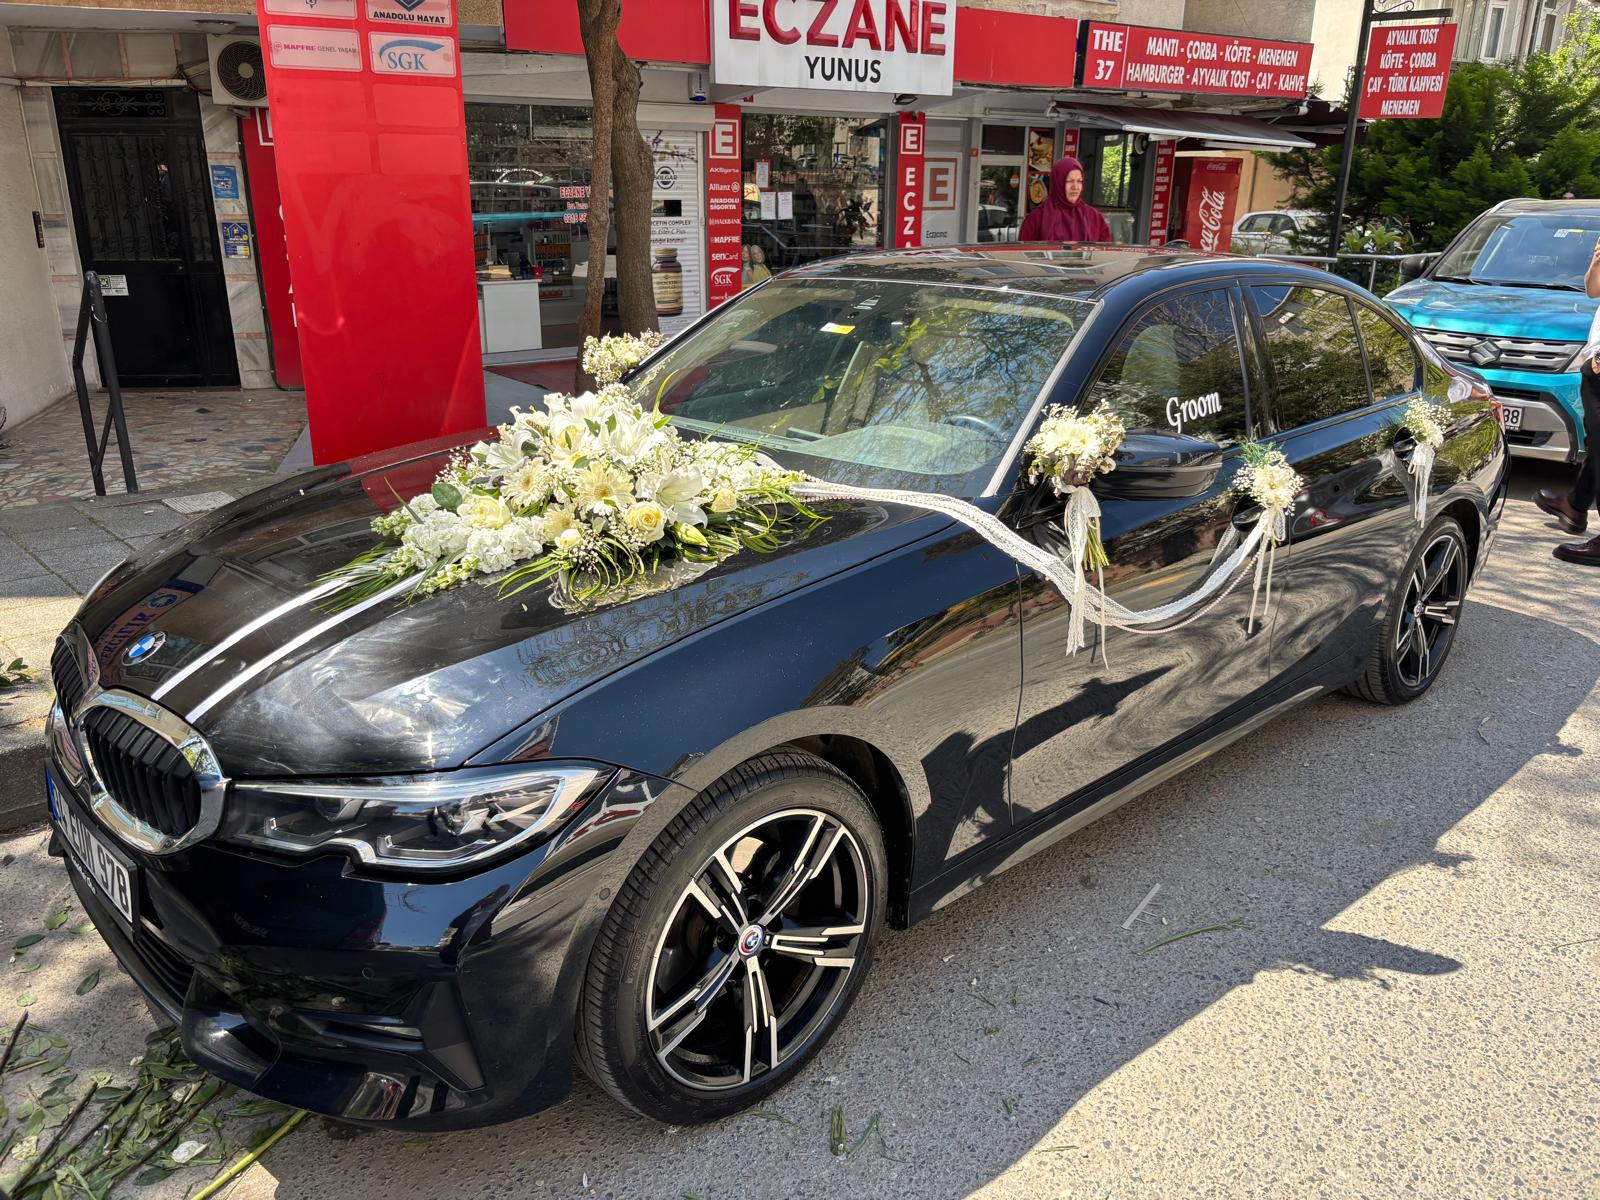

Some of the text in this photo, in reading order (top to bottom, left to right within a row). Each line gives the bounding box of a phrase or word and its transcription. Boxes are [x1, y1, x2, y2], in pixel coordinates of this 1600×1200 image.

[373, 10, 446, 24] ANADOLU HAYAT
[730, 0, 946, 56] ECZANE
[1093, 29, 1124, 53] THE
[1386, 28, 1440, 46] AYVALIK TOST
[387, 50, 429, 71] SGK
[1146, 36, 1299, 67] MANTI ÇORBA KÖFTE MENEMEN
[1380, 50, 1437, 73] KÖFTE ÇORBA
[805, 55, 882, 84] YUNUS
[1094, 59, 1115, 81] 37
[1126, 62, 1305, 94] HAMBURGER AYVALIK TOST ÇAY KAHVE
[1367, 71, 1445, 98] ÇAY TÜRK KAHVESİ
[1380, 99, 1421, 116] MENEMEN
[715, 123, 733, 155] E
[905, 129, 918, 150] E
[560, 186, 585, 198] ECZANE
[709, 183, 731, 191] Allianz
[928, 167, 949, 202] E
[713, 235, 741, 243] MAPFRE
[713, 273, 733, 285] SGK
[1165, 391, 1223, 434] Groom
[97, 842, 131, 914] 978
